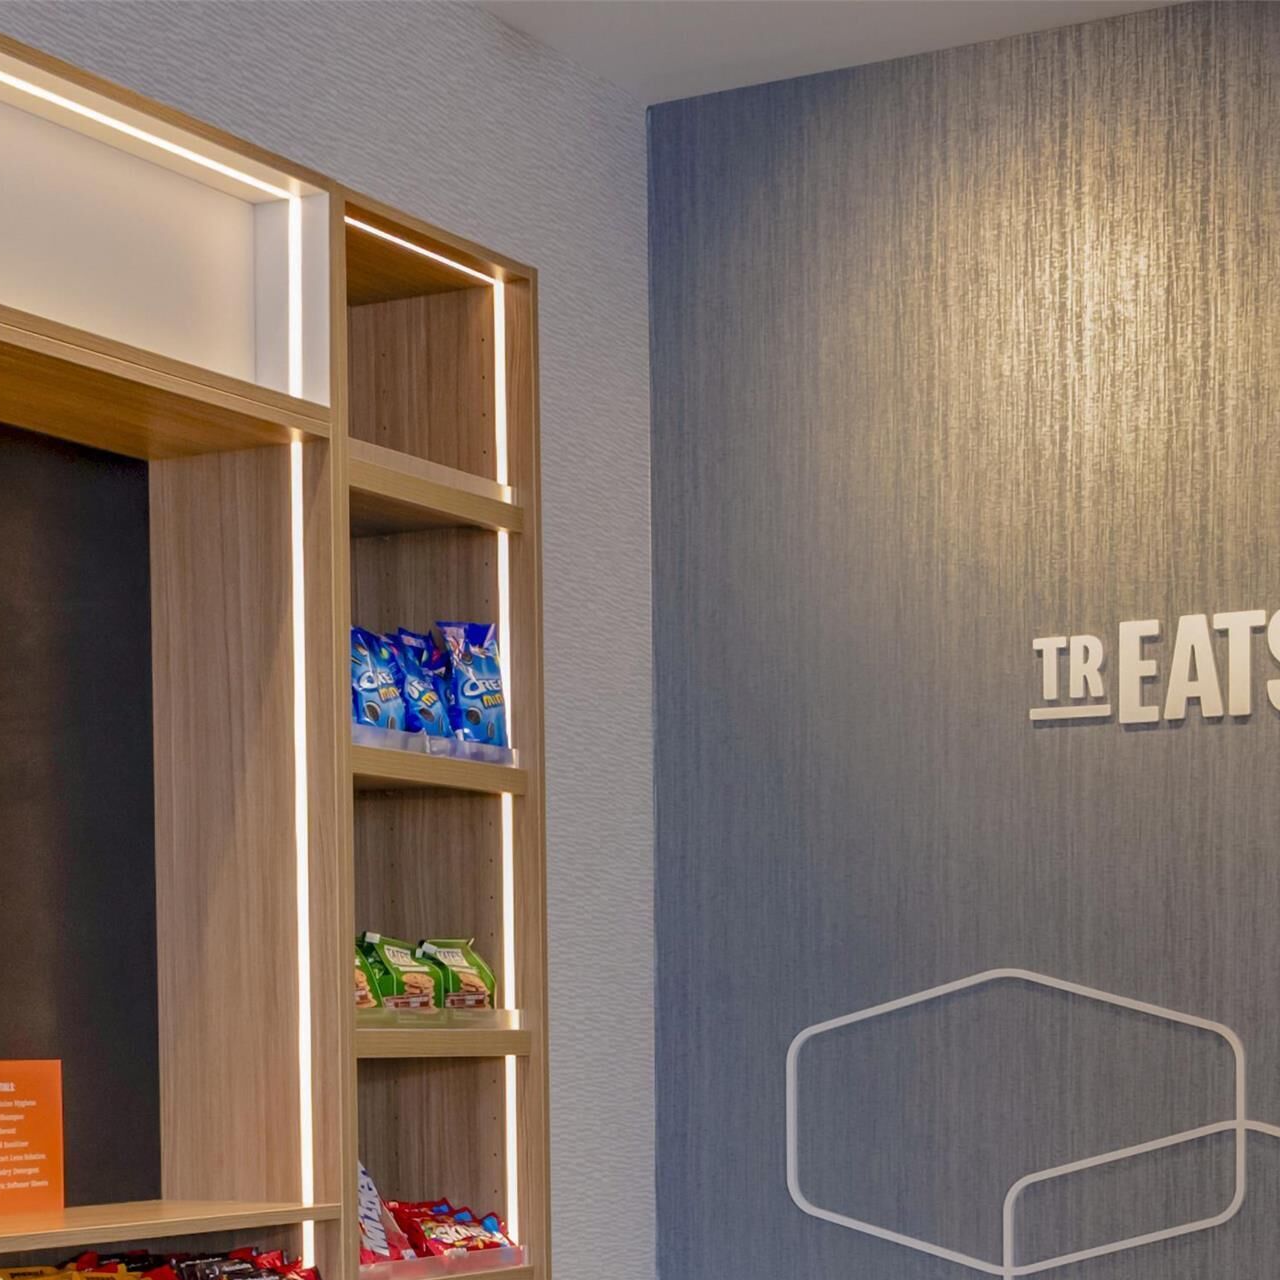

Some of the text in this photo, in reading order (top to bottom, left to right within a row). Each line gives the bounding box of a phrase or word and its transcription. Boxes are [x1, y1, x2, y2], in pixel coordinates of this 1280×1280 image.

[14, 1099, 37, 1109] Hygiene
[4, 1139, 29, 1149] Sanitizer
[11, 1153, 23, 1163] Lens
[12, 1166, 40, 1176] Detergent
[6, 1180, 30, 1190] Softener
[30, 1179, 49, 1188] Sheets
